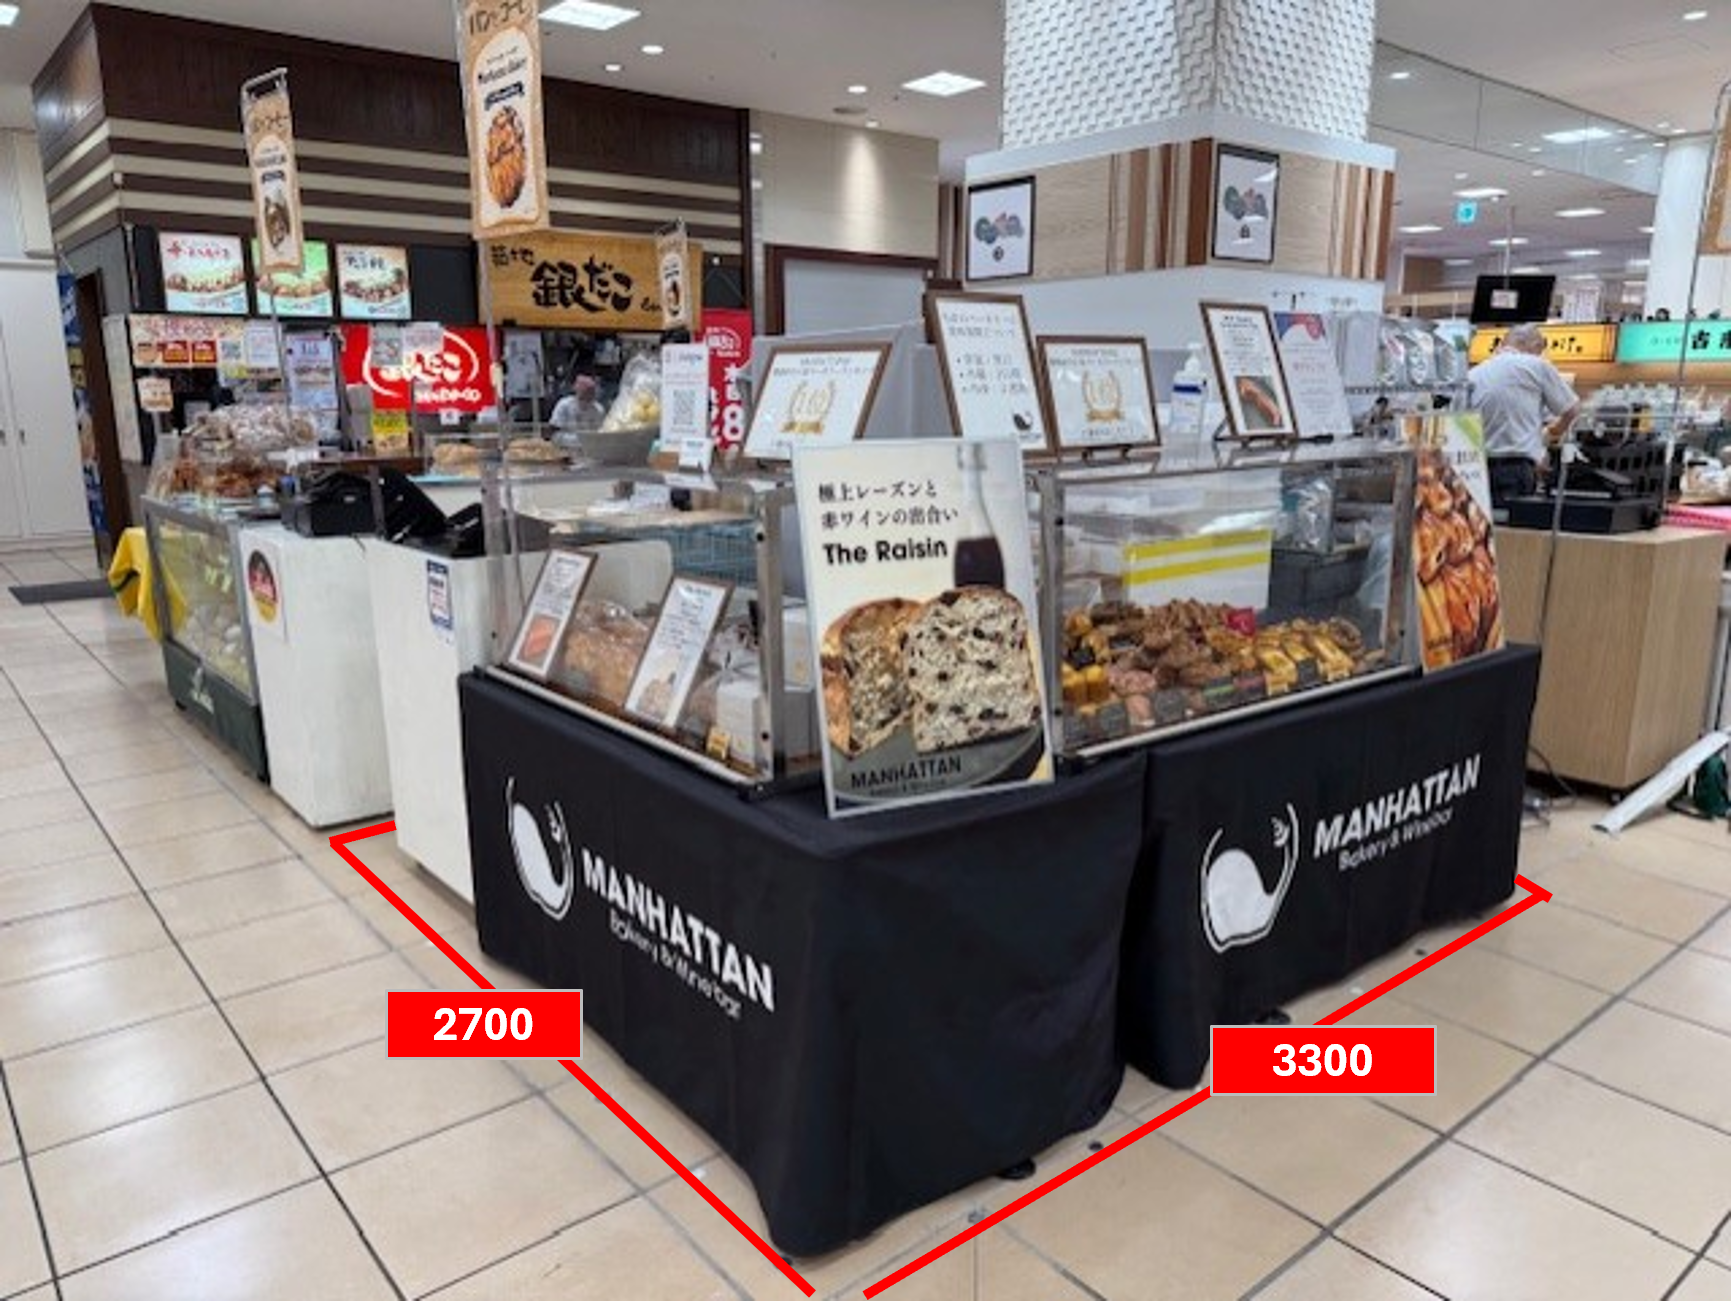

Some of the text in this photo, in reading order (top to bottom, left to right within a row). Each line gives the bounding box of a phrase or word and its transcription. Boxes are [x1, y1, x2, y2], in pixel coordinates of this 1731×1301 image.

[530, 254, 634, 314] 銀だこ
[818, 481, 938, 502] 極上レーズンと
[821, 505, 959, 529] 赤ワインの出合い
[823, 538, 949, 566] The Raisin
[851, 755, 962, 789] MANHATTAN
[1313, 753, 1480, 859] MANHATTAN
[582, 848, 775, 1012] MANHATTAN
